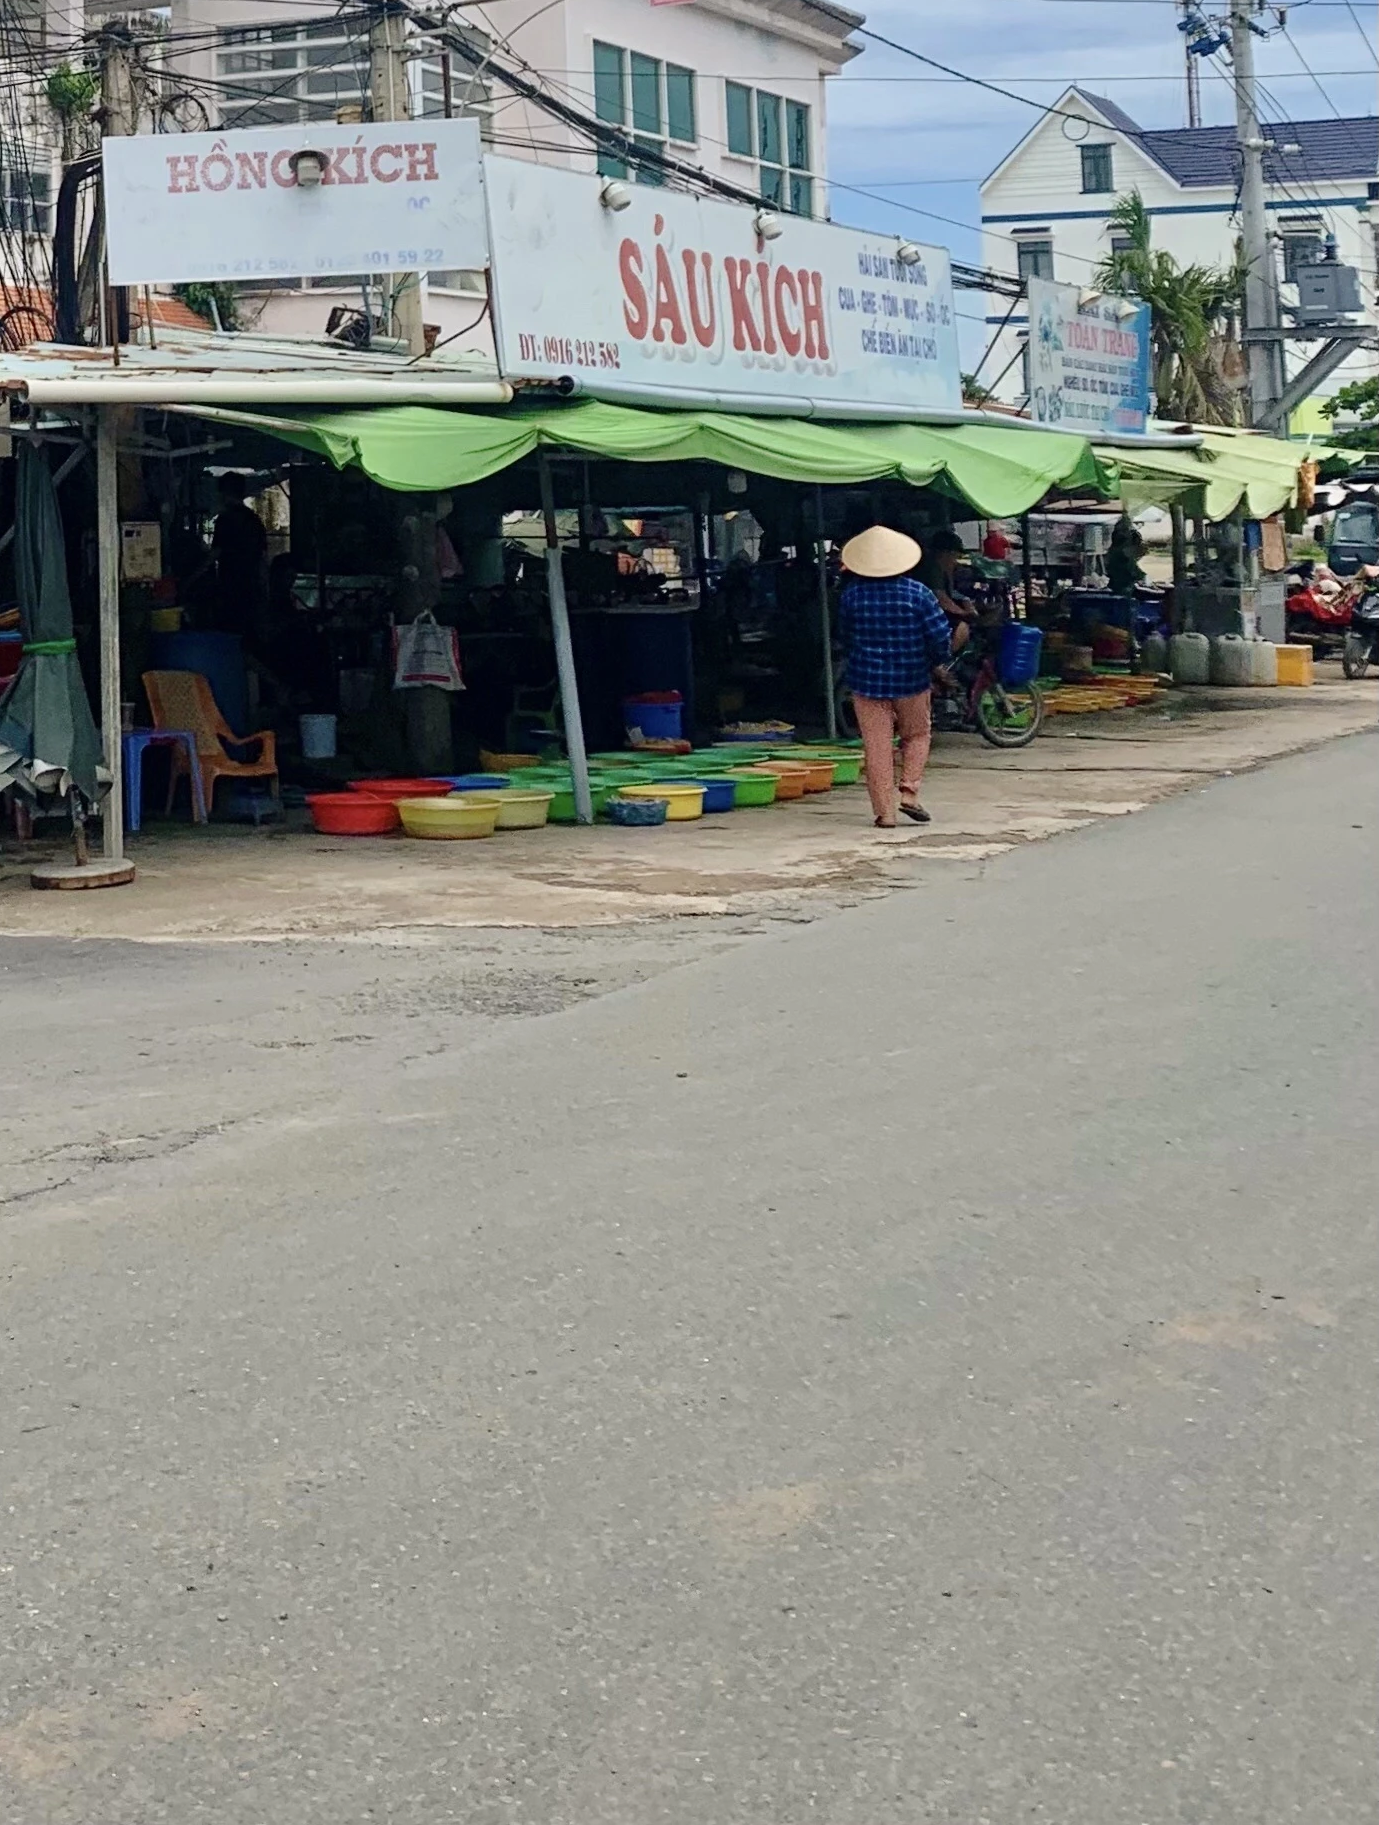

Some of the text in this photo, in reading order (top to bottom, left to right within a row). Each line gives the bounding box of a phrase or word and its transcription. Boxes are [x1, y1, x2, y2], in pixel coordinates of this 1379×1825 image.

[320, 134, 440, 185] KÍCH
[233, 258, 263, 272] 212
[397, 249, 418, 264] 59
[424, 248, 445, 263] 22
[619, 213, 830, 361] SÁU KÍCH
[544, 336, 573, 365] 0916
[575, 338, 597, 367] 212
[598, 342, 620, 369] 582
